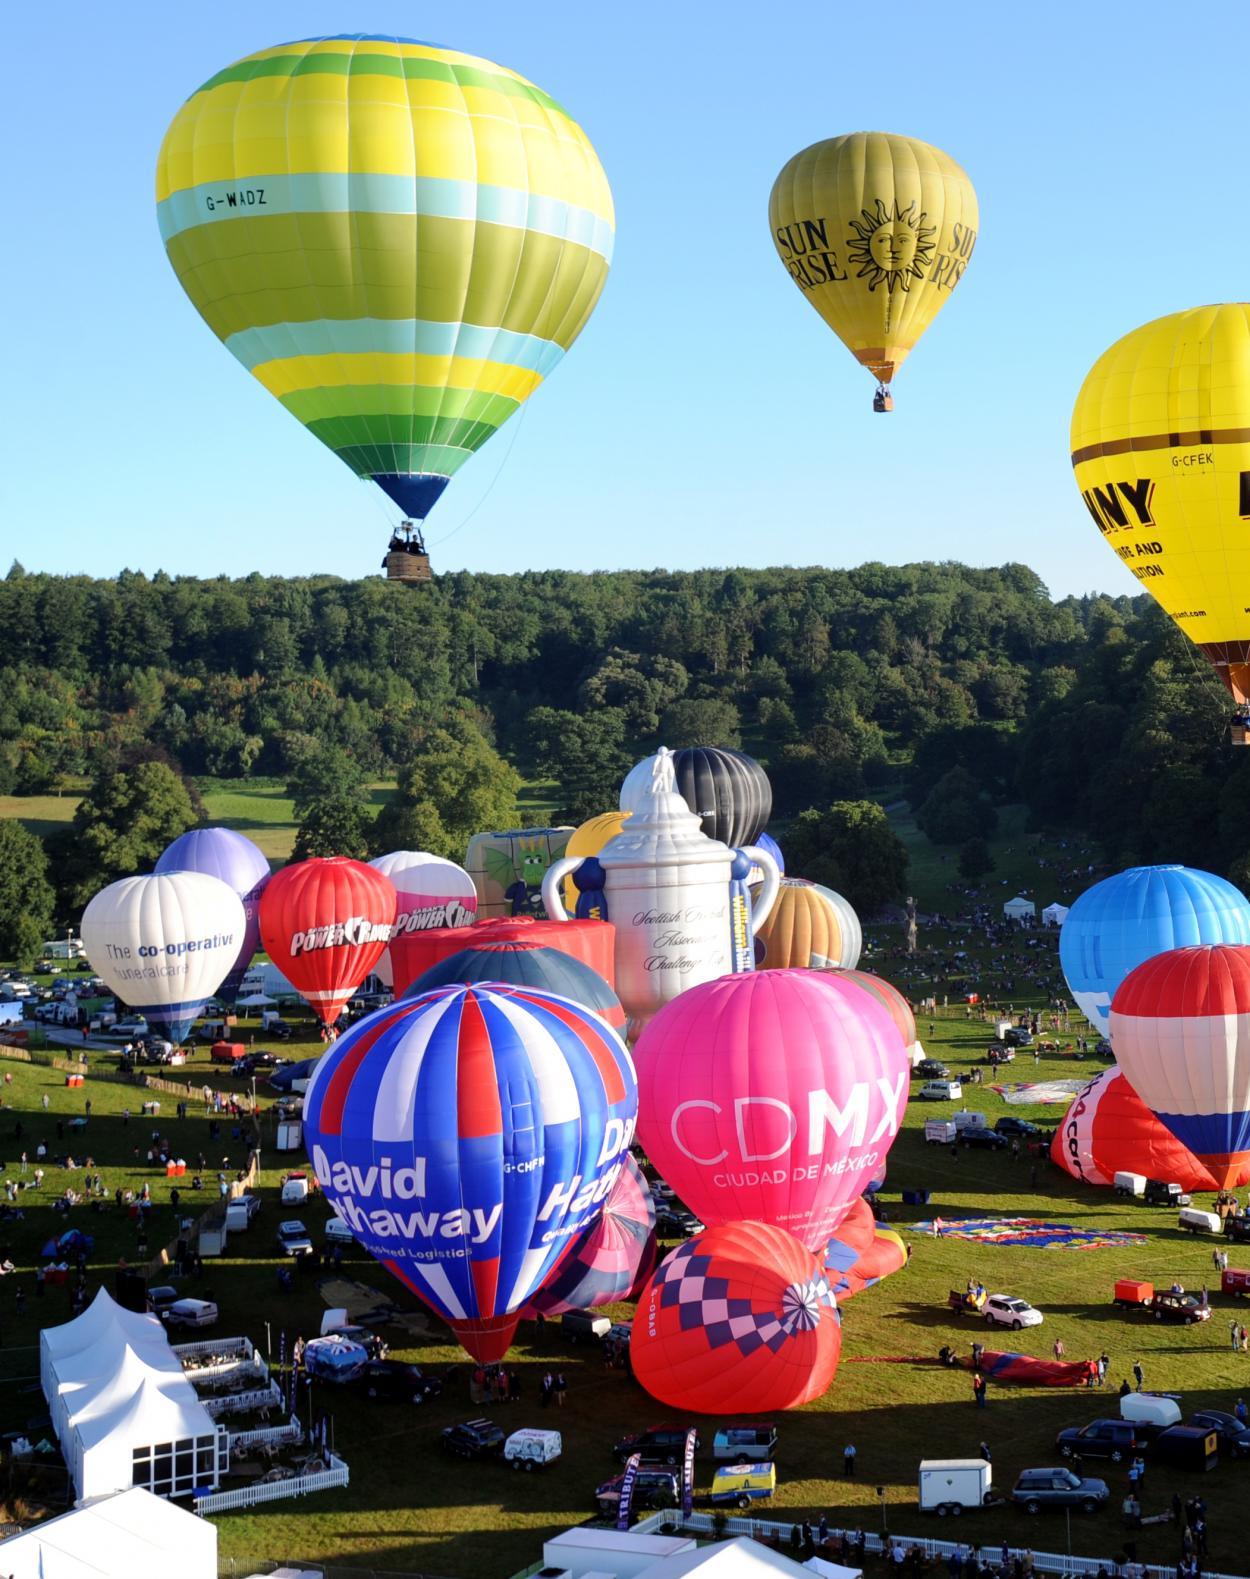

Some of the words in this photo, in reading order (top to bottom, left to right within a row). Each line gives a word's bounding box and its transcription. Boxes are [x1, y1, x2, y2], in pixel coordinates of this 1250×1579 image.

[206, 189, 267, 211] G-WADZ
[777, 217, 830, 259] SUN
[949, 222, 977, 260] SU
[782, 252, 848, 291] RISE
[929, 252, 967, 292] RIS
[1172, 452, 1214, 467] G-CFEK
[1135, 541, 1163, 556] AND
[392, 910, 446, 937] POWER
[632, 906, 683, 925] Scottish
[106, 943, 131, 960] The
[138, 933, 234, 959] co-operative
[290, 925, 345, 957] POWER
[114, 962, 189, 982] funeralcare
[671, 1071, 906, 1166] CDMX
[312, 1144, 426, 1199] David
[503, 1155, 545, 1174] G-CHFN
[713, 1170, 787, 1188] CIUDAD
[793, 1165, 819, 1181] DE
[823, 1151, 879, 1177] MÉXICO
[408, 1247, 473, 1261] Logistics
[619, 1457, 640, 1519] TRIBUTE
